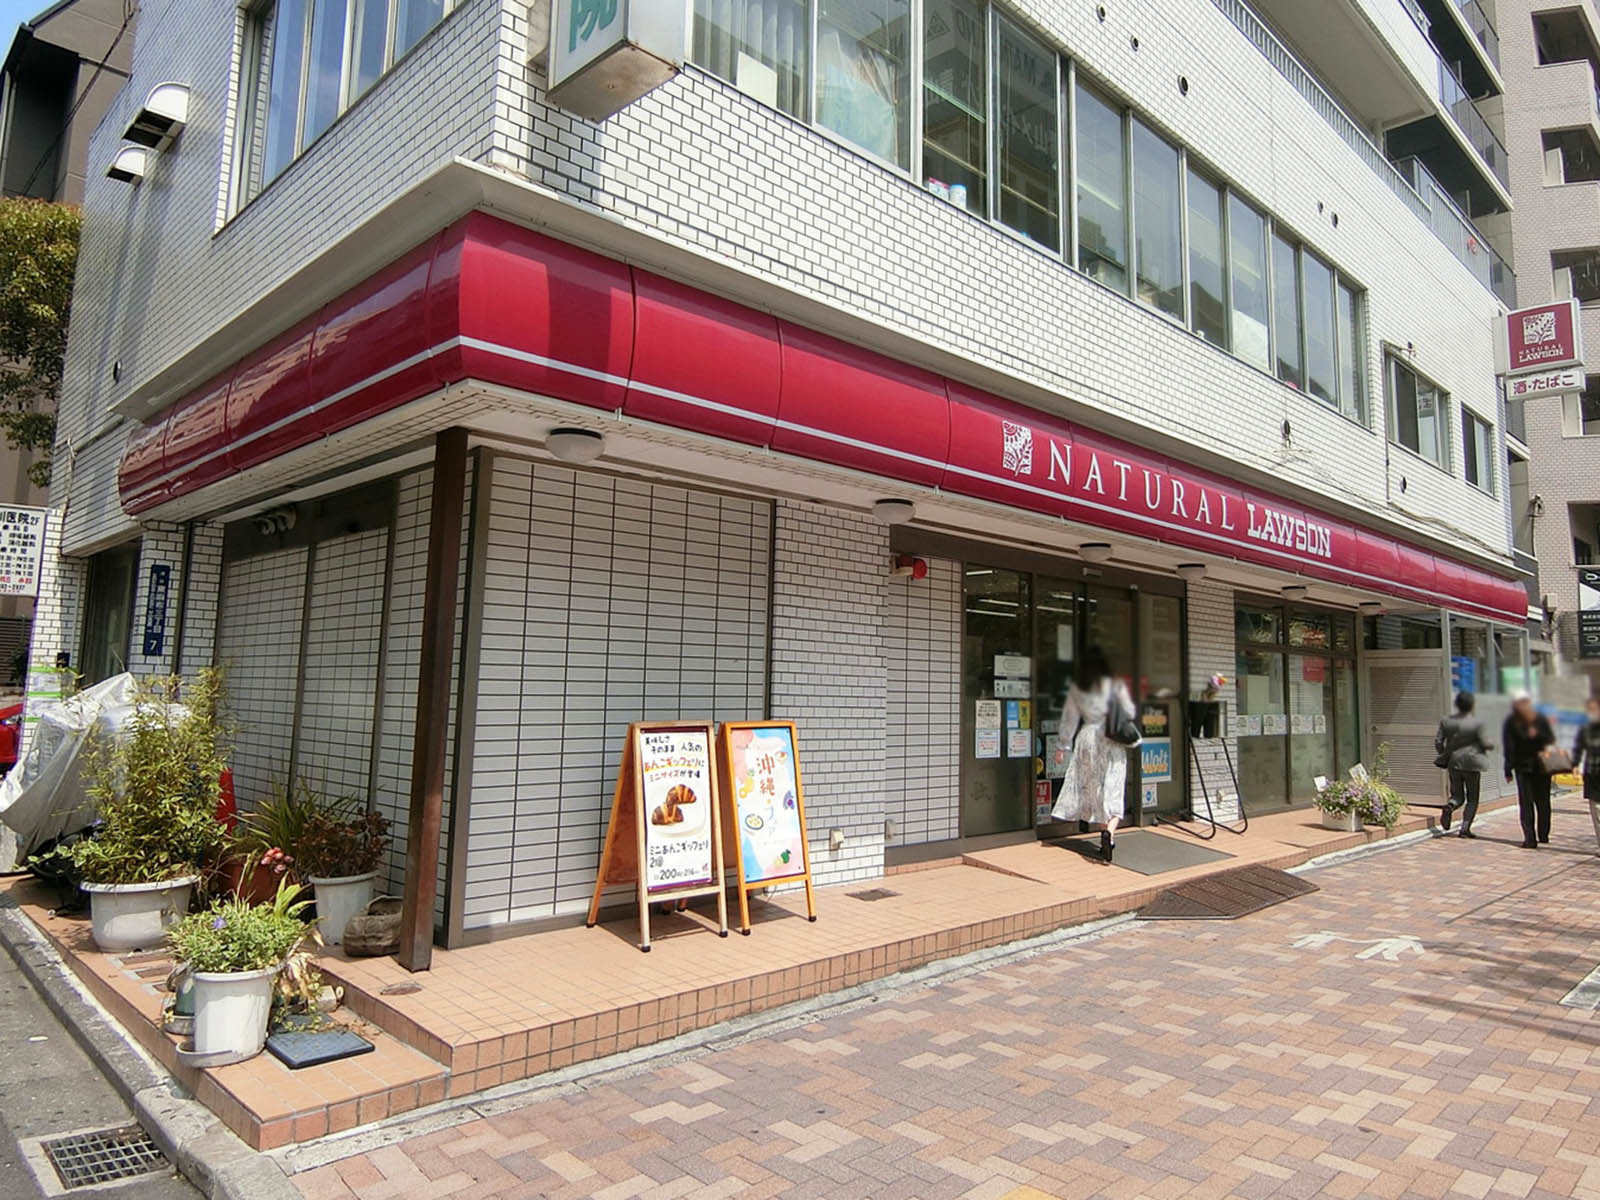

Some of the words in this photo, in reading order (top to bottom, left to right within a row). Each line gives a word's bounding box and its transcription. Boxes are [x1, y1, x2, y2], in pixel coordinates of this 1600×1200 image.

[1519, 348, 1564, 362] LAWSON
[1048, 439, 1235, 530] NATURAL
[1247, 503, 1332, 558] LAWSON
[149, 640, 158, 651] 7
